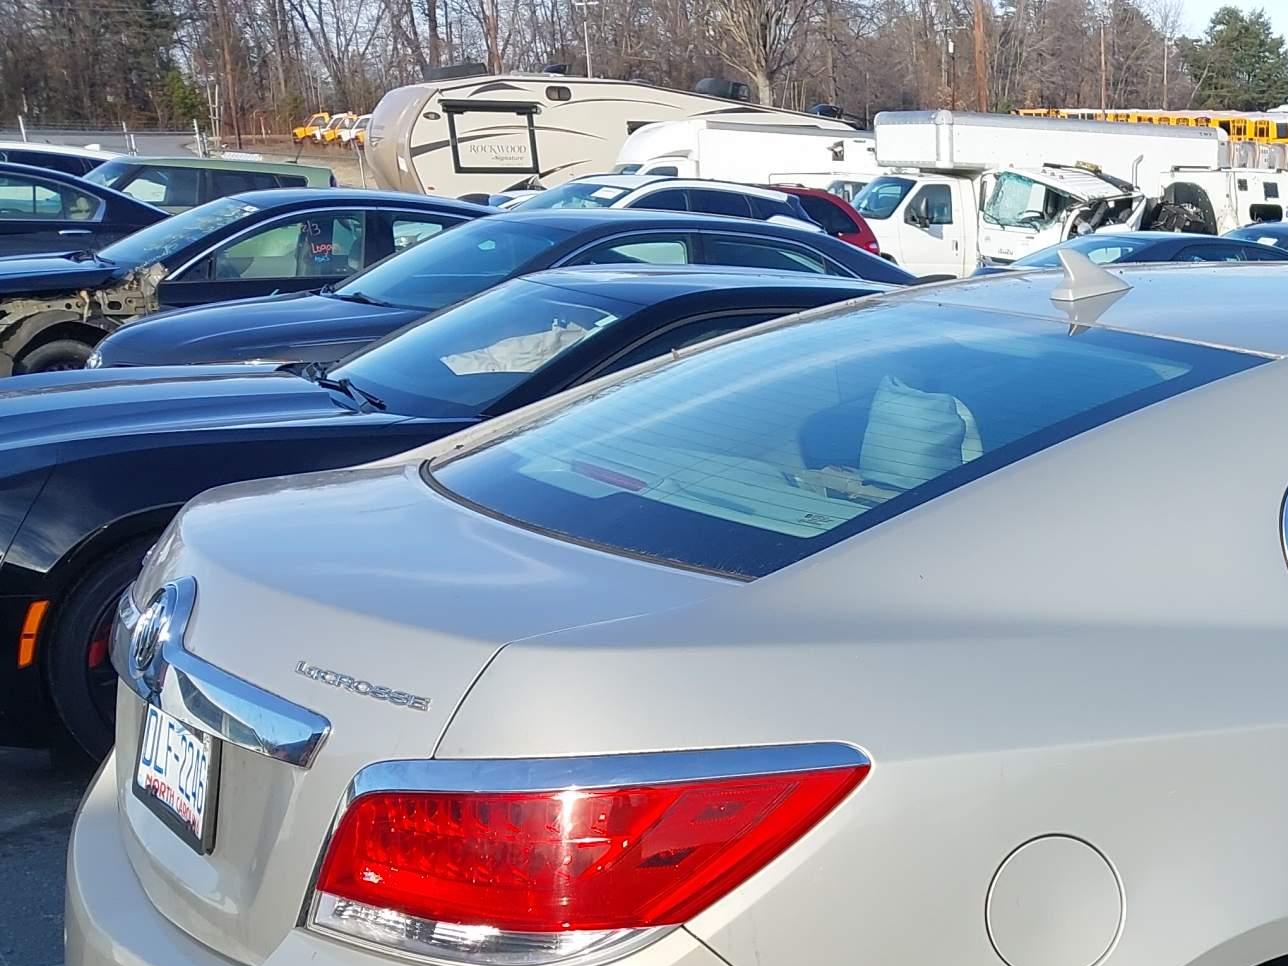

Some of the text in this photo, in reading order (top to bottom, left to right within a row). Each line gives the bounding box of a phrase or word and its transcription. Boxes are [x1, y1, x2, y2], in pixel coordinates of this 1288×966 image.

[469, 144, 527, 154] ROCKWOOD
[141, 708, 207, 815] DLF-2246
[145, 773, 175, 806] NORTH
